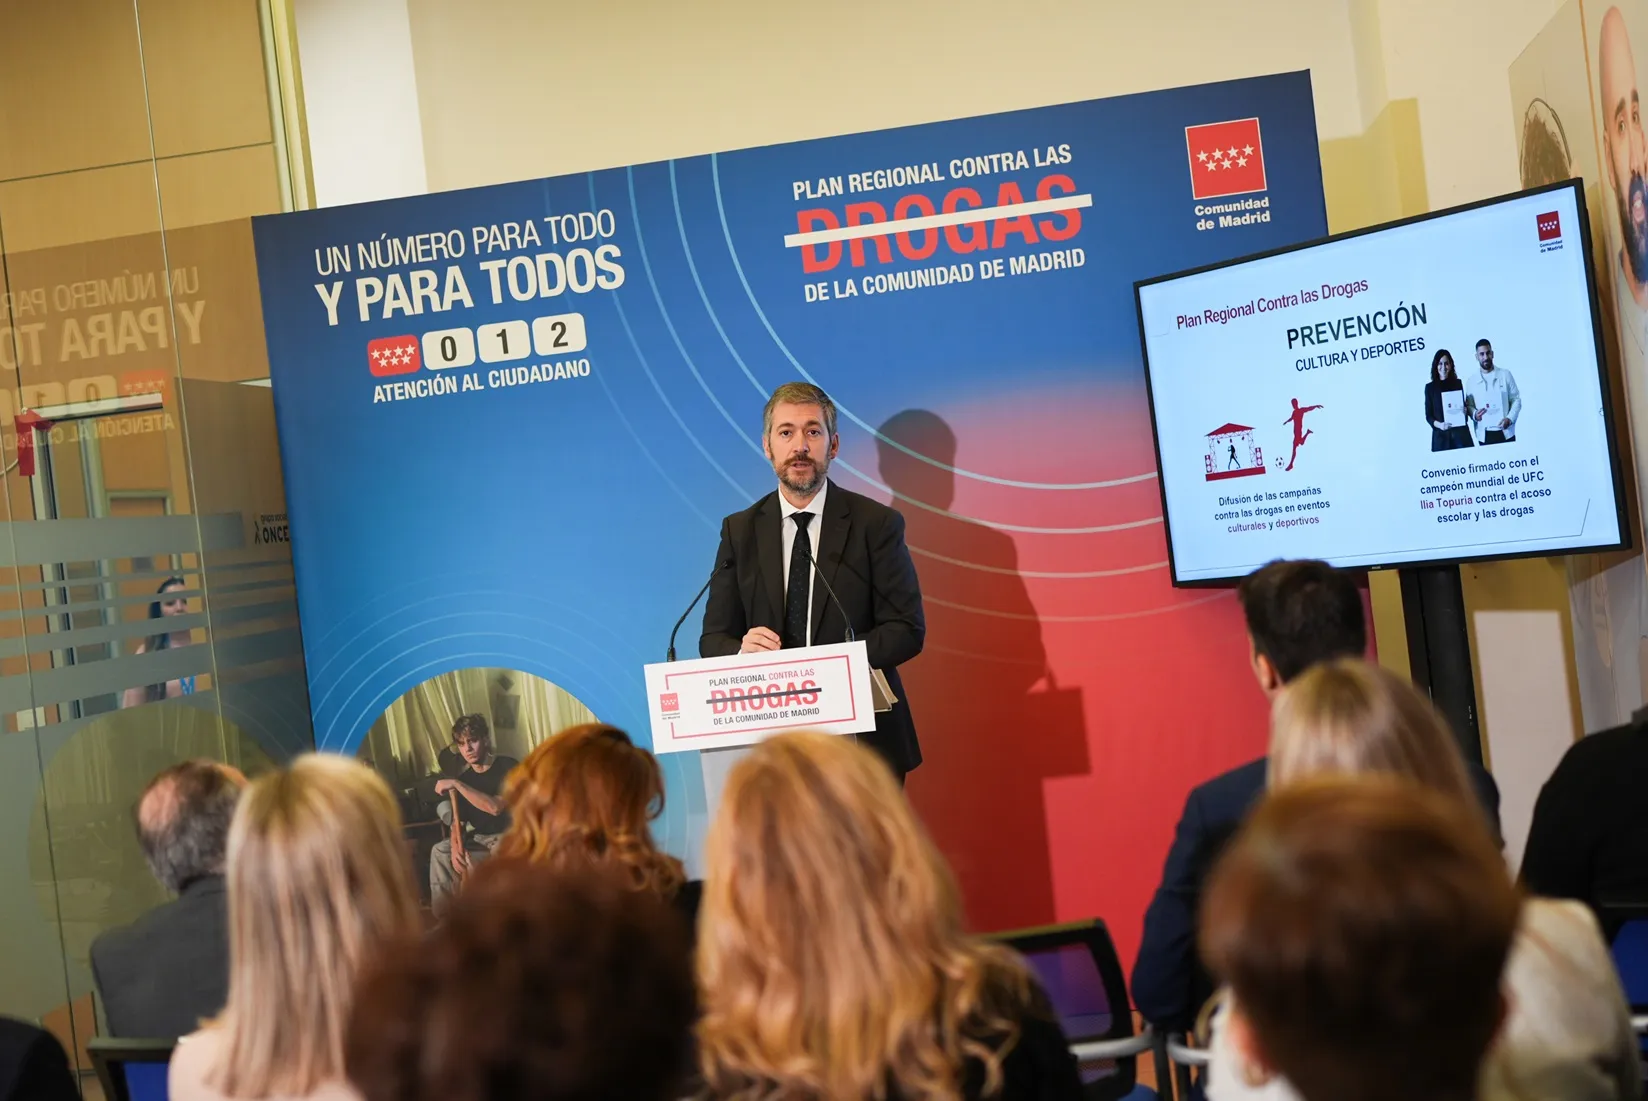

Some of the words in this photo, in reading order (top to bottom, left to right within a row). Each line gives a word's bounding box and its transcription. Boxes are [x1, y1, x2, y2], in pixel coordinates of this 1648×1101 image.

[792, 176, 843, 200] PLAN
[849, 162, 945, 192] REGIONAL
[949, 150, 1029, 179] CONTRA
[1033, 144, 1072, 167] LAS
[1194, 196, 1270, 216] Comunidad
[796, 173, 1082, 274] DROGAS
[1196, 218, 1215, 231] de
[1219, 210, 1271, 228] Madrid
[315, 245, 351, 276] UN
[358, 229, 466, 270] NÚMERO
[472, 220, 541, 255] PARA
[544, 209, 616, 244] TODO
[314, 281, 344, 326] Y
[356, 265, 474, 322] PARA
[479, 244, 625, 304] TODOS
[804, 282, 829, 303] DE
[834, 278, 858, 299] LA
[862, 263, 974, 295] COMUNIDAD
[980, 259, 1005, 280] DE
[1010, 248, 1086, 276] MADRID
[1176, 314, 1202, 330] Plan
[1204, 300, 1255, 324] Regional
[1257, 294, 1298, 313] Contra
[1300, 289, 1319, 305] las
[1322, 279, 1369, 300] Drogas
[1287, 301, 1428, 350] PREVENCIÓN
[440, 336, 458, 362] 0
[496, 328, 510, 354] 1
[550, 321, 569, 348] 2
[1296, 350, 1349, 372] CULTURA
[1350, 350, 1359, 362] Y
[1361, 337, 1425, 360] DEPORTES
[373, 374, 458, 404] ATENCIÓN
[462, 373, 484, 392] AL
[488, 358, 590, 388] CIUDADANO
[1421, 465, 1466, 479] Convenio
[1468, 461, 1506, 474] firmado
[1509, 458, 1528, 468] con
[1530, 456, 1539, 466] el
[1420, 481, 1463, 495] campeón
[1466, 476, 1505, 489] mundial
[1508, 475, 1520, 484] de
[1522, 471, 1544, 483] UFC
[1219, 494, 1251, 506] Difusión
[1253, 493, 1263, 502] de
[1265, 492, 1277, 501] las
[1280, 486, 1321, 499] campañas
[1436, 495, 1473, 509] Topuria
[1475, 492, 1506, 504] contra
[1509, 490, 1518, 500] el
[1521, 488, 1551, 499] acoso
[1214, 510, 1239, 520] contra
[1241, 509, 1252, 518] las
[1254, 505, 1283, 516] drogas
[1285, 504, 1295, 512] en
[1297, 500, 1330, 511] eventos
[1437, 511, 1471, 523] escolar
[1474, 511, 1480, 521] y
[1482, 508, 1497, 518] las
[1500, 505, 1534, 518] drogas
[263, 525, 290, 544] ONCE
[1228, 521, 1266, 533] culturales
[1268, 522, 1273, 530] y
[1275, 516, 1320, 529] deportivos
[709, 677, 729, 687] PLAN
[730, 674, 766, 684] REGIONAL
[768, 671, 799, 681] CONTRA
[800, 668, 815, 677] LAS
[710, 680, 819, 714] DROGAS
[714, 717, 723, 725] DE
[725, 716, 734, 724] LA
[735, 712, 778, 723] COMUNIDAD
[780, 711, 789, 719] DE
[791, 708, 820, 717] MADRID
